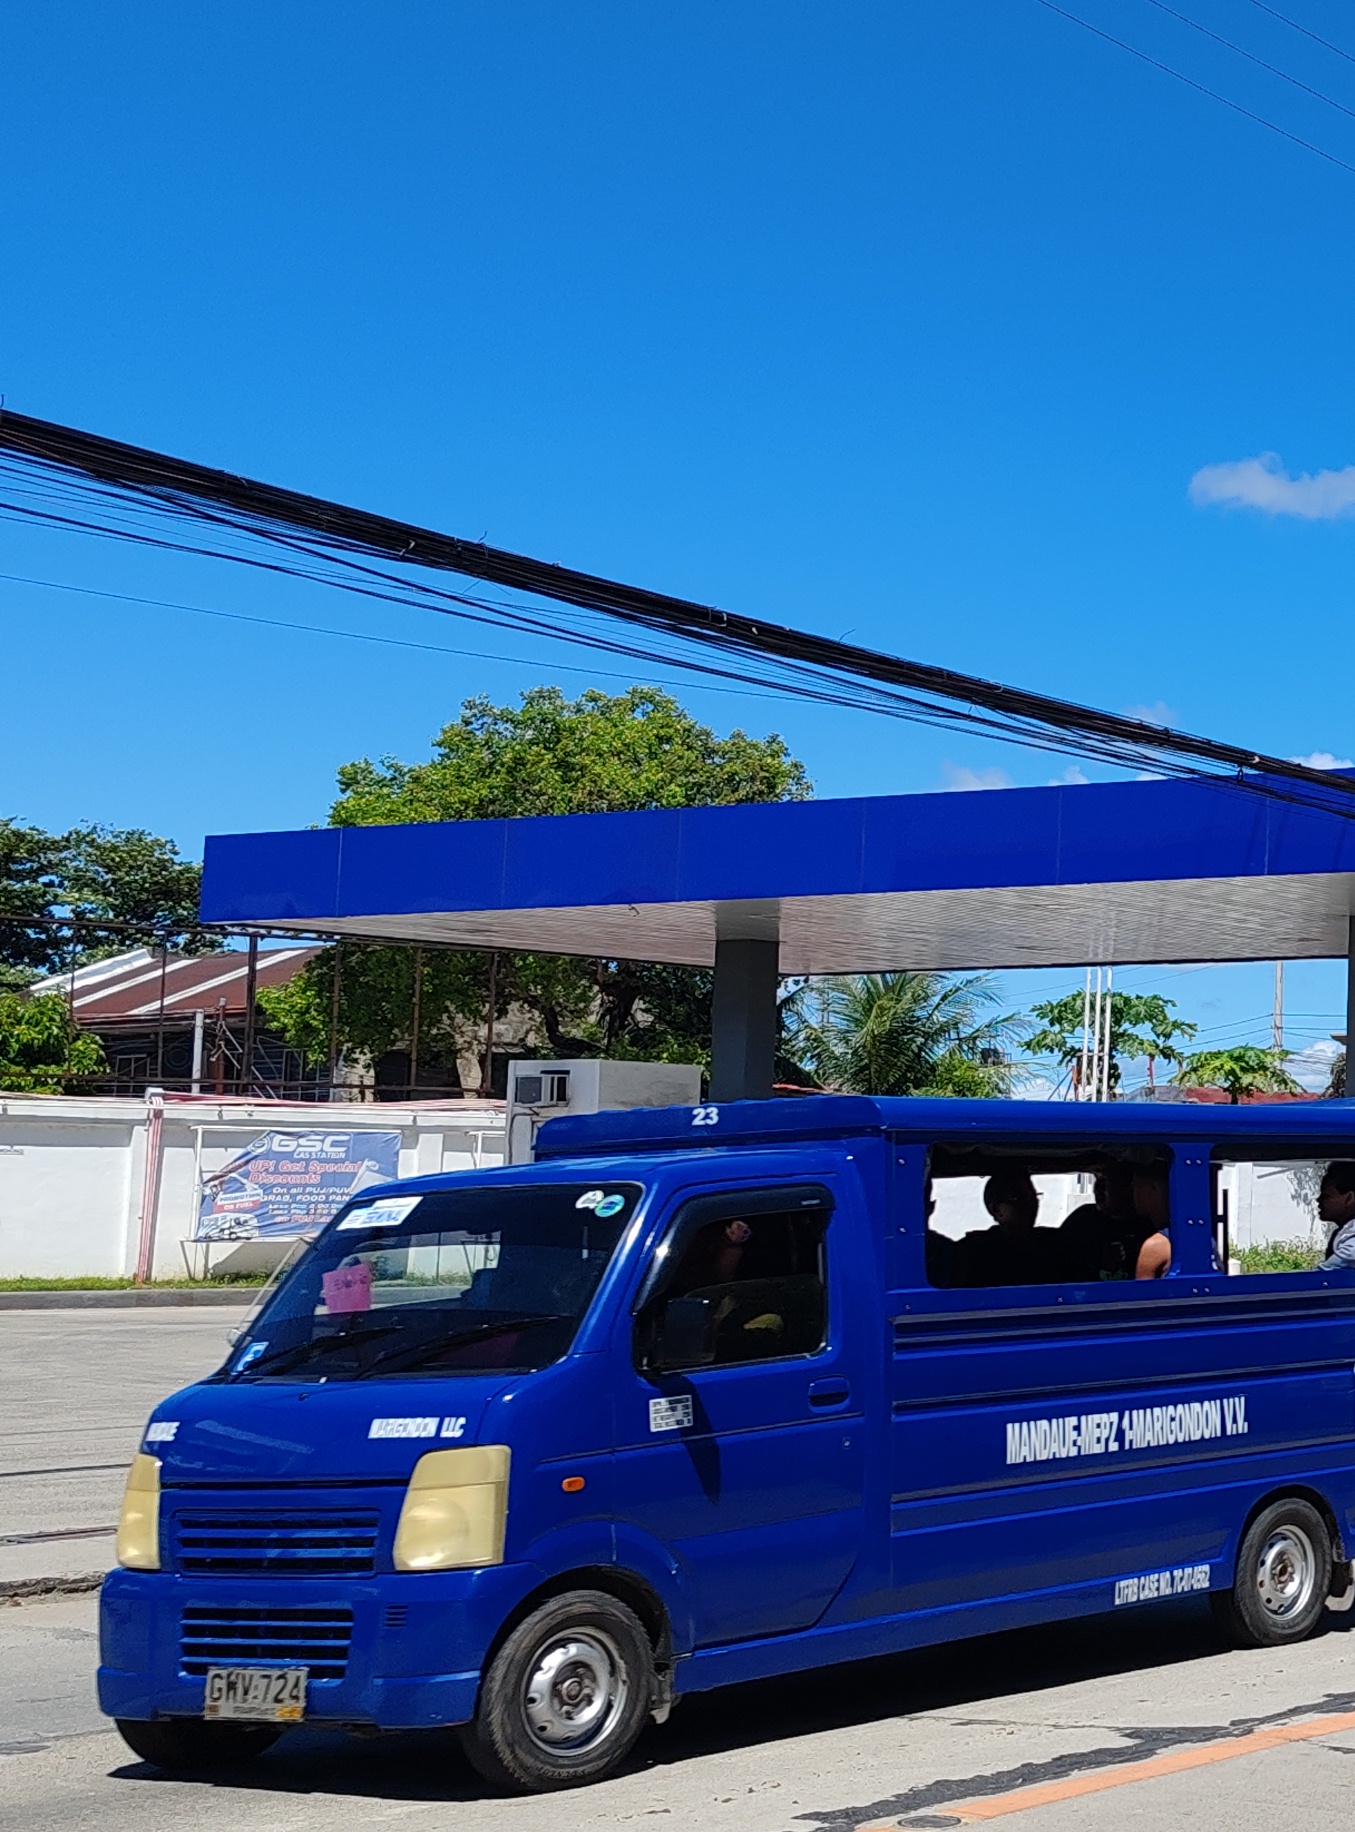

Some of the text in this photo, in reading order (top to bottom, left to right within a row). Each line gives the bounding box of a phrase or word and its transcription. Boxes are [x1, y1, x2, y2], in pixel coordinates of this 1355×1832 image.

[691, 1106, 719, 1126] 23
[271, 1135, 351, 1152] GSC
[310, 1151, 346, 1159] STATION
[249, 1160, 276, 1173] UP!
[279, 1160, 306, 1173] Get
[1006, 1411, 1119, 1465] MANDAUE-MEPZ
